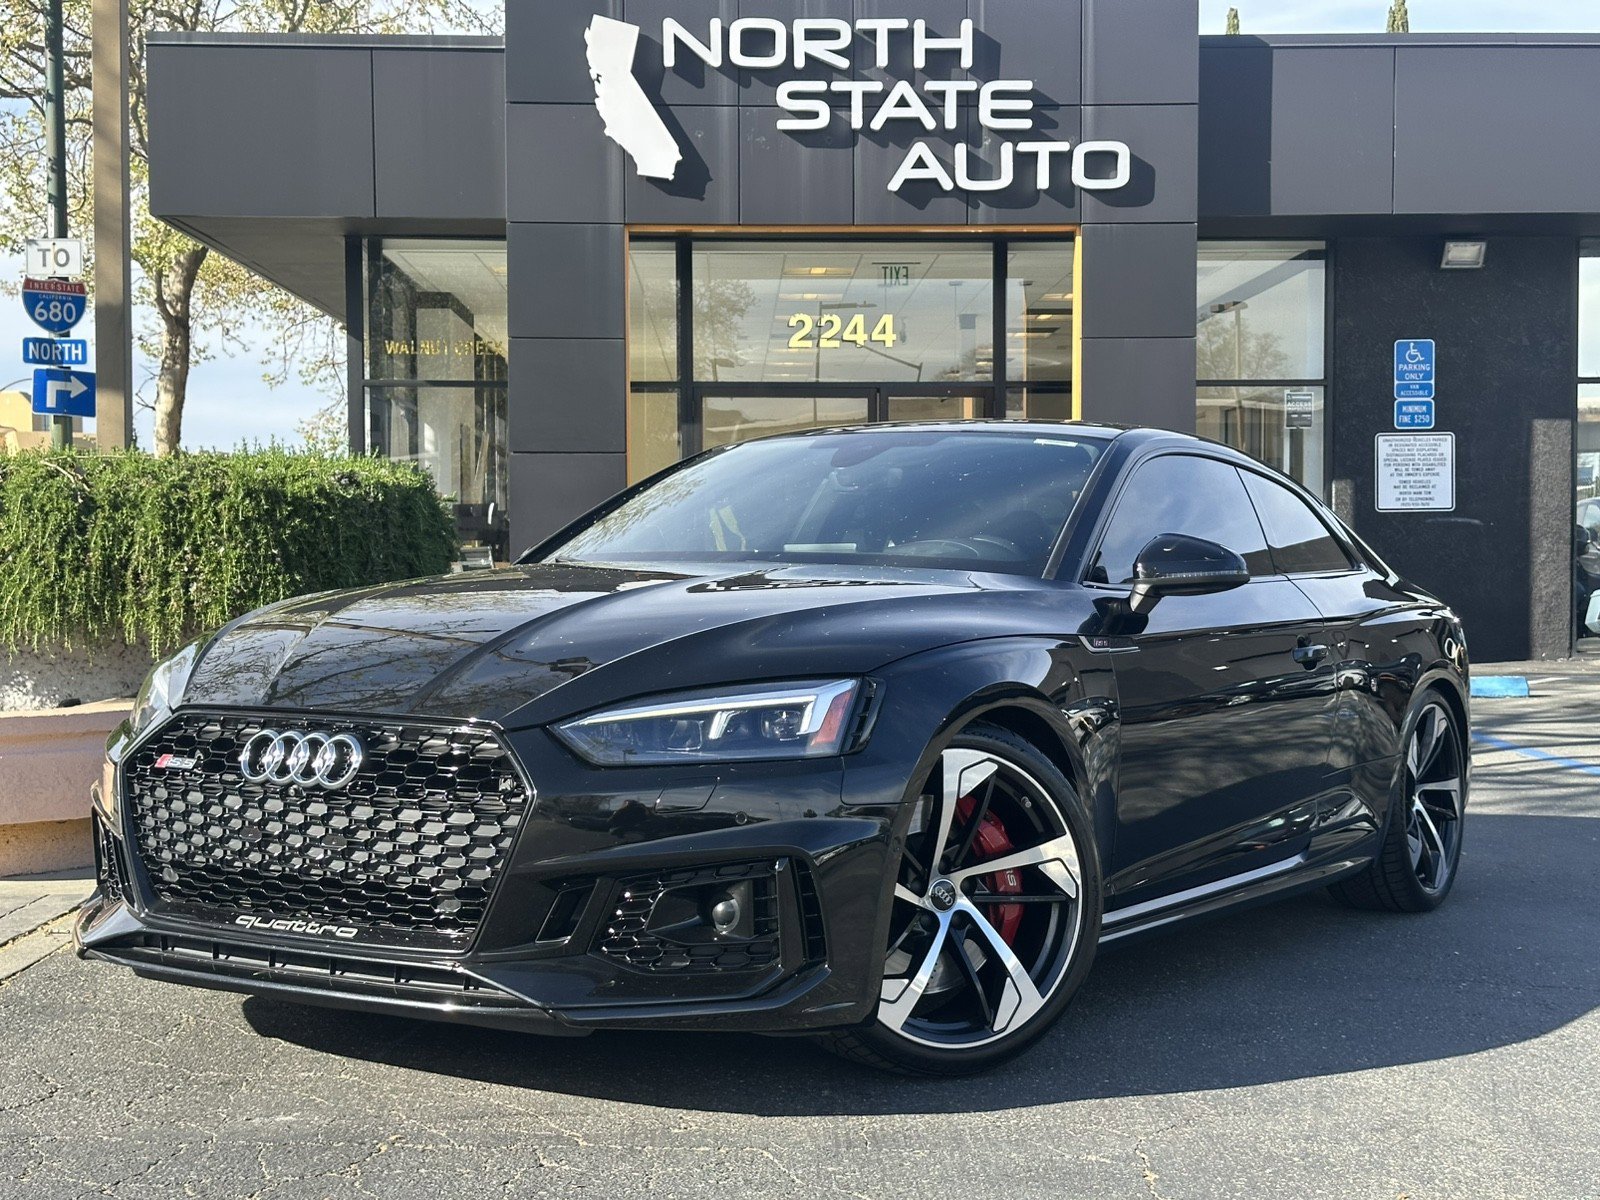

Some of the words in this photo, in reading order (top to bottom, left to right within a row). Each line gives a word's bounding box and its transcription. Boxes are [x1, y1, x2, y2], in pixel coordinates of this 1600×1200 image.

[662, 17, 973, 69] NORTH
[776, 80, 1034, 132] STATE
[887, 140, 1131, 192] AUTO
[37, 248, 70, 268] TO
[29, 281, 81, 293] INTERSTATE
[34, 300, 76, 324] 680
[787, 313, 897, 348] 2244
[28, 342, 82, 361] NORTH
[384, 339, 449, 356] WALNUT
[1398, 363, 1431, 371] PARKING
[1398, 415, 1411, 423] FINE
[1414, 415, 1430, 423] $250
[235, 914, 359, 938] quattro
